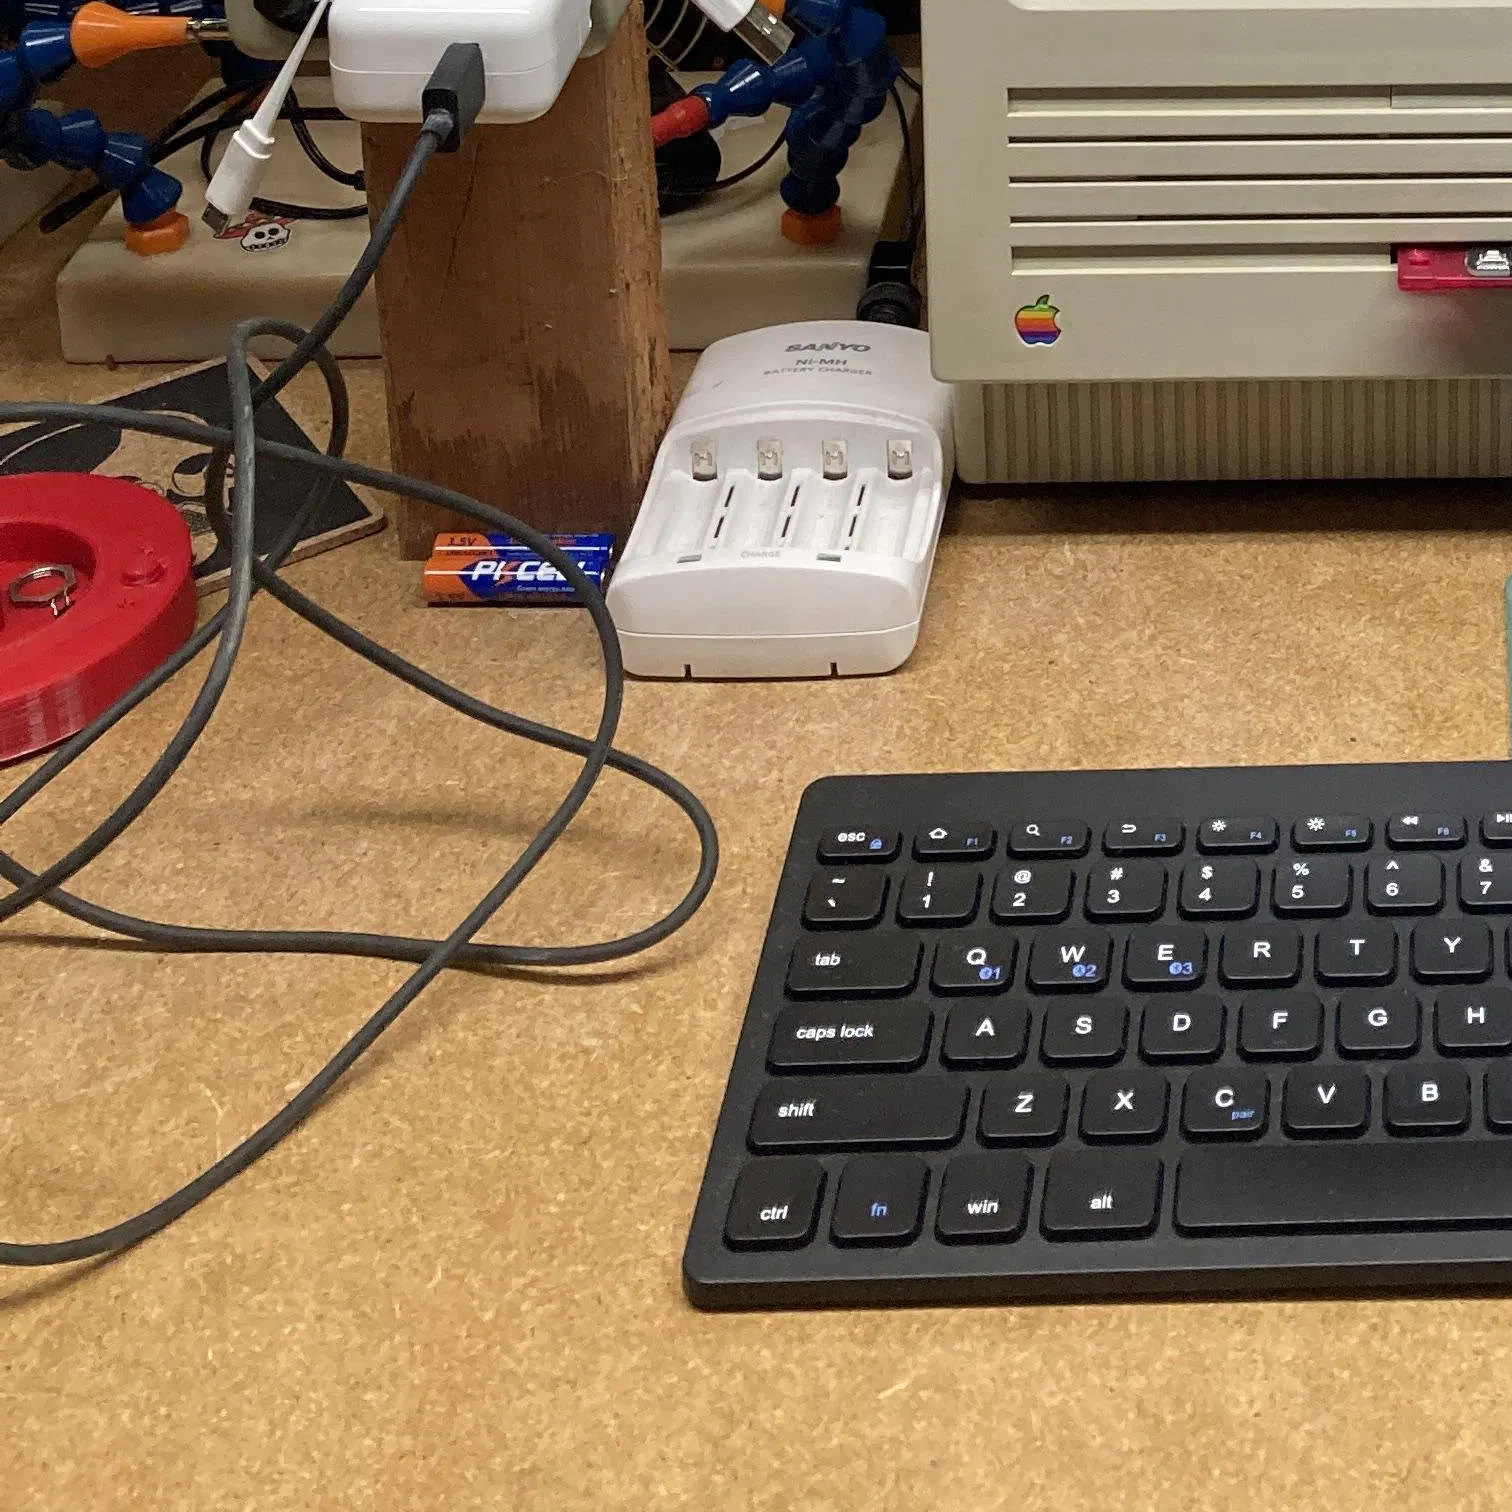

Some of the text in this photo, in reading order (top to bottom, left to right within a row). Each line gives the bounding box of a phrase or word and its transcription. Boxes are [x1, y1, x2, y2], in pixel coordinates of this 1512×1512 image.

[784, 341, 872, 353] SANYO
[838, 832, 865, 842] esc
[815, 952, 840, 965] tab
[1468, 1007, 1485, 1024] H
[796, 1024, 873, 1041] caps lock
[1215, 1087, 1233, 1107] C
[1318, 1083, 1335, 1103] V
[1422, 1082, 1438, 1101] B
[1013, 1093, 1033, 1112] Z
[1114, 1090, 1133, 1110] X
[778, 1103, 814, 1117] shift
[968, 1200, 998, 1214] win
[1089, 1193, 1113, 1209] alt
[760, 1206, 788, 1220] ctrl
